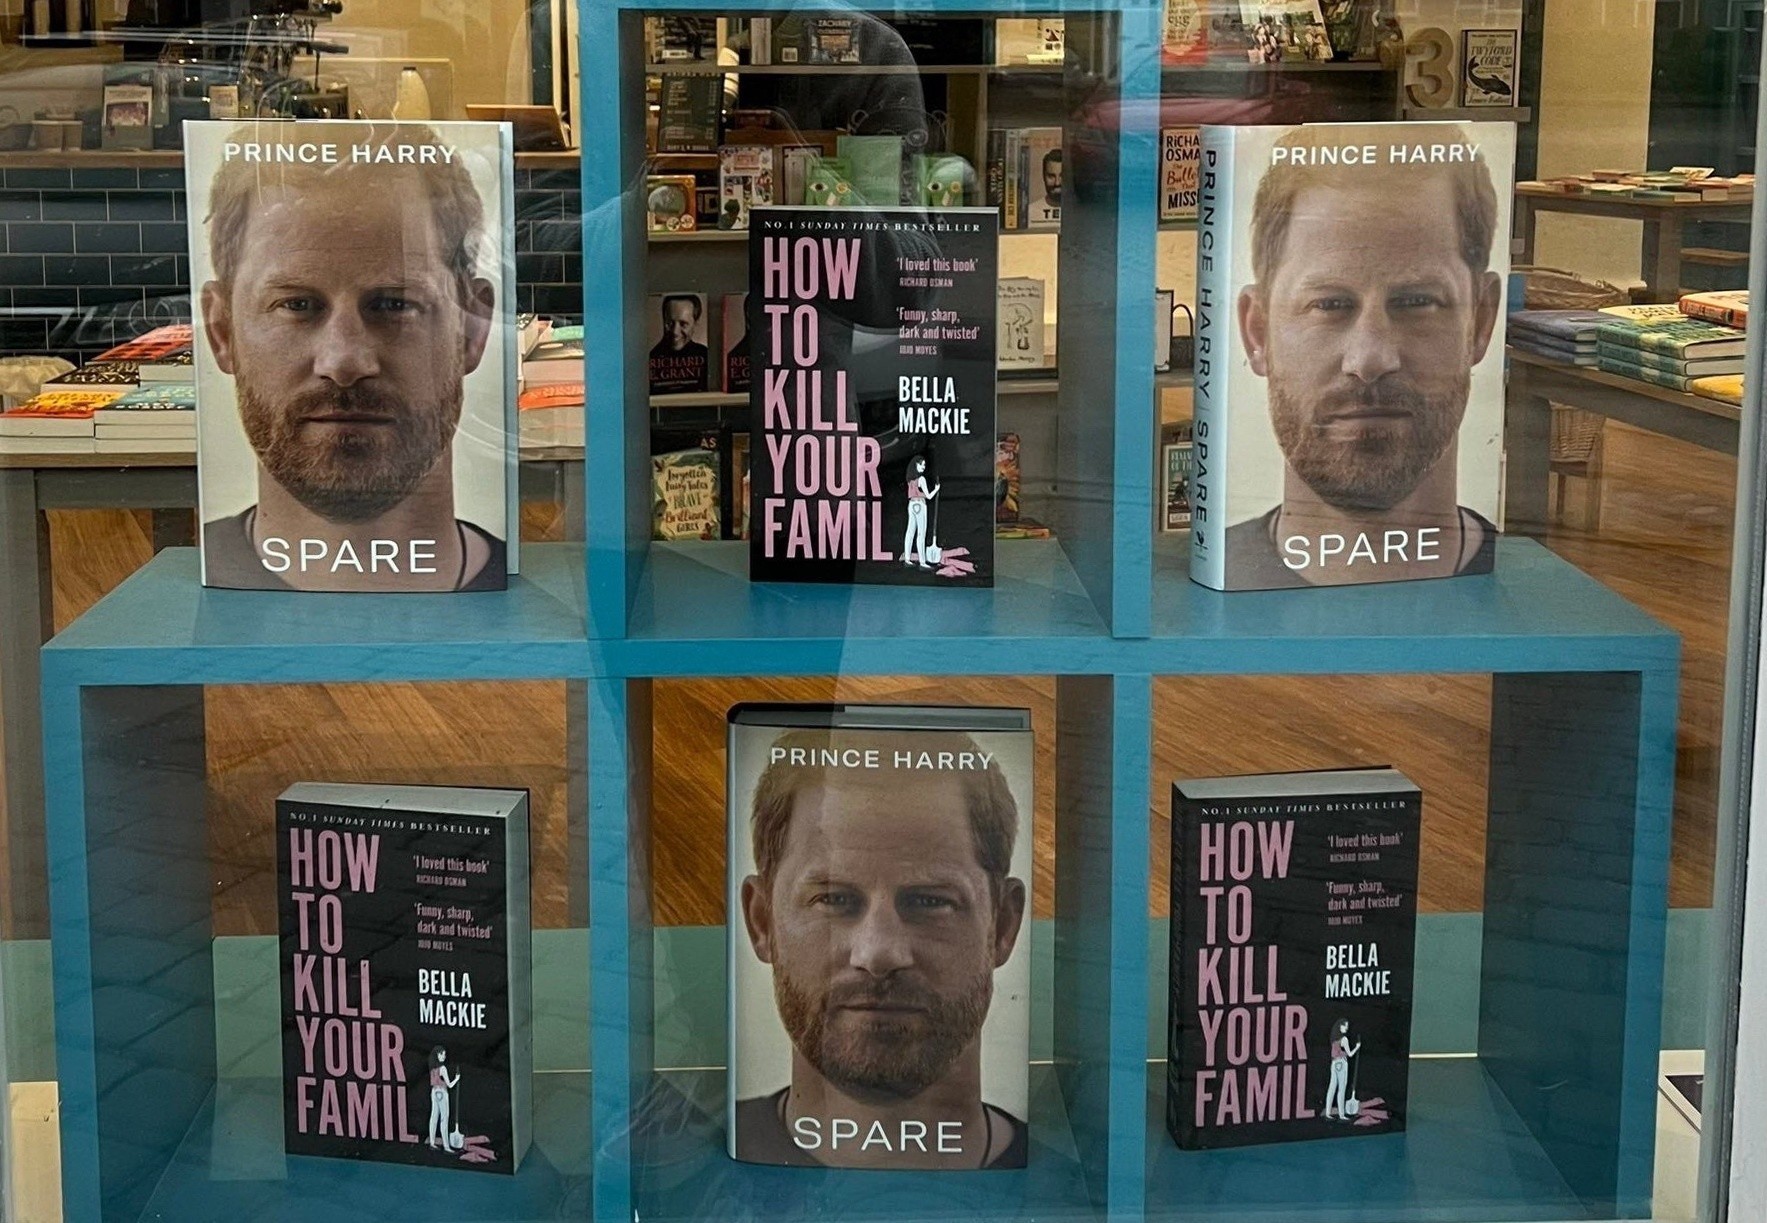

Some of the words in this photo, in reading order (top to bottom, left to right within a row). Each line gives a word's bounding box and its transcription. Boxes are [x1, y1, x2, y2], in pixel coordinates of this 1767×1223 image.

[1404, 27, 1454, 108] 3
[224, 143, 338, 163] PRINCE
[352, 144, 457, 164] HARRY
[1272, 145, 1377, 166] PRINCE
[1390, 143, 1480, 164] HARRY
[765, 221, 793, 230] NO.1
[800, 222, 847, 230] SUNDAY
[853, 222, 889, 231] TIMES
[894, 223, 981, 232] BESTSELLER
[1202, 150, 1216, 272] PRINCE
[764, 236, 861, 300] HOW
[905, 257, 930, 271] loved
[932, 258, 951, 272] this
[899, 325, 920, 339] dark
[922, 326, 940, 339] and
[931, 308, 960, 324] sharp,
[764, 304, 819, 367] TO
[1199, 288, 1212, 399] HARRY
[764, 369, 858, 431] KILL
[899, 376, 956, 403] BELLA
[899, 407, 971, 435] MACKIE
[765, 434, 883, 497] YOUR
[1196, 420, 1209, 522] SPARE
[764, 498, 894, 561] FAMIL
[261, 537, 437, 573] SPARE
[1283, 527, 1440, 570] SPARE
[770, 747, 879, 768] PRINCE
[894, 750, 994, 770] HARRY
[323, 815, 365, 826] SUNDAY
[371, 818, 405, 829] TIMES
[410, 822, 491, 836] BESTSELLER
[1236, 805, 1280, 815] SUNDAY
[1286, 804, 1321, 813] TIMES
[1326, 800, 1406, 811] BESTSELLER
[1200, 820, 1295, 882] HOW
[1335, 833, 1359, 848] loved
[1361, 833, 1378, 847] this
[290, 827, 380, 893] HOW
[421, 855, 445, 871] loved
[447, 857, 464, 872] this
[446, 905, 474, 923] sharp,
[1200, 884, 1252, 945] TO
[1328, 897, 1347, 911] dark
[1349, 896, 1365, 910] and
[291, 891, 343, 954] TO
[417, 920, 437, 934] dark
[439, 923, 455, 936] and
[1326, 942, 1378, 970] BELLA
[293, 953, 382, 1019] KILL
[418, 968, 473, 998] BELLA
[1198, 945, 1288, 1006] KILL
[1325, 970, 1391, 999] MACKIE
[419, 998, 487, 1029] MACKIE
[295, 1015, 406, 1082] YOUR
[1198, 1004, 1308, 1067] YOUR
[297, 1076, 419, 1144] FAMIL
[1195, 1063, 1316, 1128] FAMIL
[793, 1116, 962, 1153] SPARE
